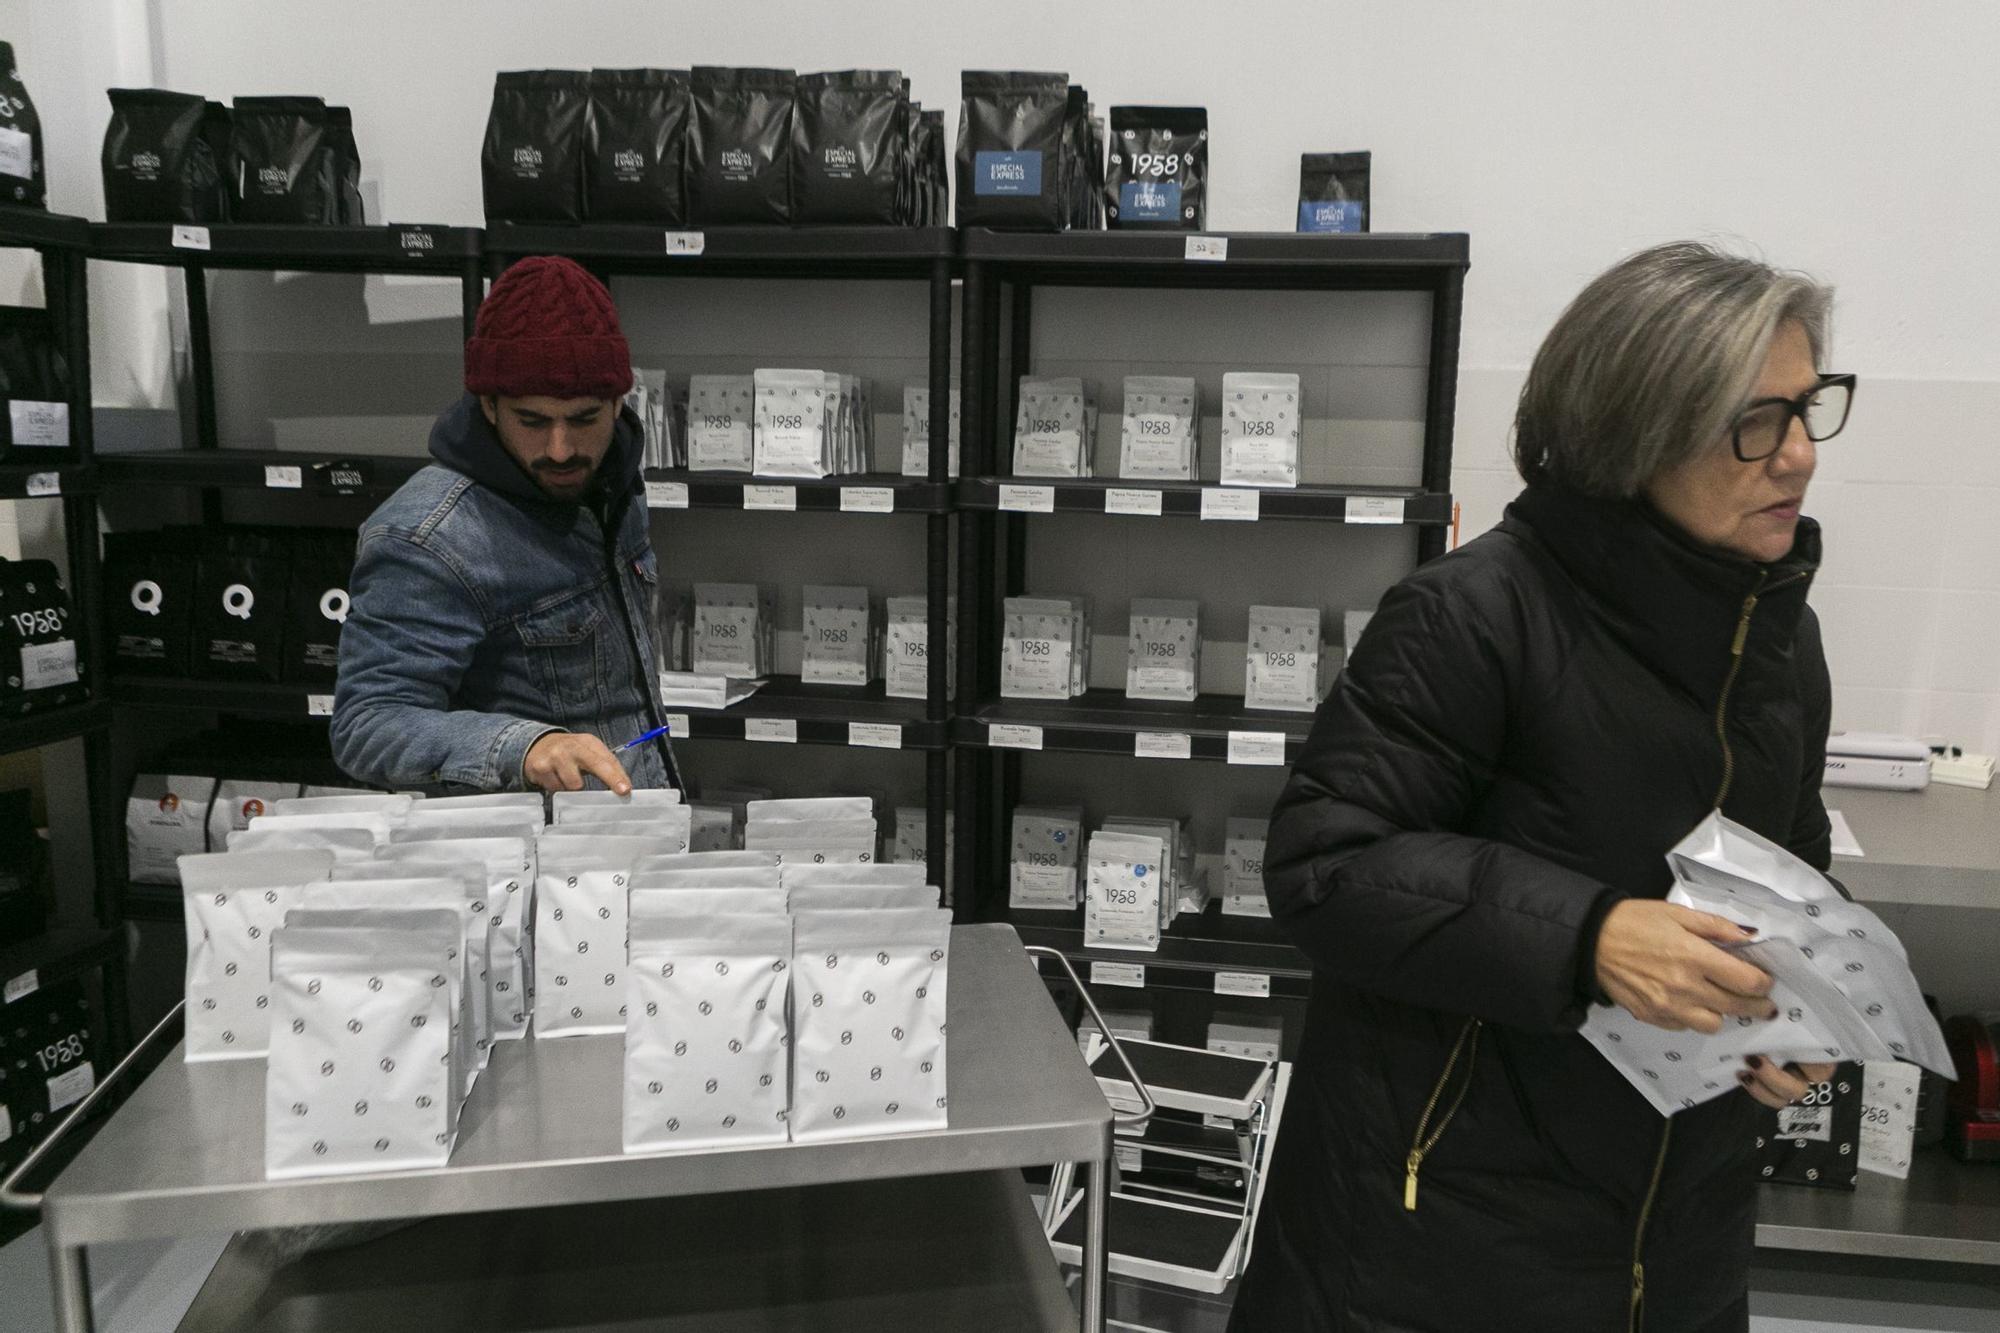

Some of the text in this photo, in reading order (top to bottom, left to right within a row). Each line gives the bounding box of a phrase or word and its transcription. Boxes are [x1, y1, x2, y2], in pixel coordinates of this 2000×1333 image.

[991, 164, 1023, 173] ESPECIAL
[1130, 153, 1179, 176] 1958
[991, 171, 1025, 180] EXPRESS
[1134, 200, 1166, 208] EXPRESS
[704, 415, 732, 429] 1958
[772, 415, 802, 429] 1958
[1032, 419, 1061, 433] 1958
[1140, 420, 1171, 435] 1958
[1242, 420, 1275, 436] 1958
[130, 579, 163, 616] Q
[222, 583, 255, 620] Q
[319, 587, 350, 624] Q
[11, 608, 62, 636] 1958
[711, 624, 738, 639] 1958
[820, 628, 848, 643] 1958
[905, 641, 928, 656] 195
[1021, 640, 1050, 655] 1958
[1147, 642, 1176, 657] 1958
[1265, 652, 1296, 667] 1958
[911, 848, 927, 863] 19
[1028, 852, 1058, 867] 1958
[1242, 859, 1264, 873] 195
[1105, 888, 1137, 905] 1958
[36, 1034, 84, 1072] 1958
